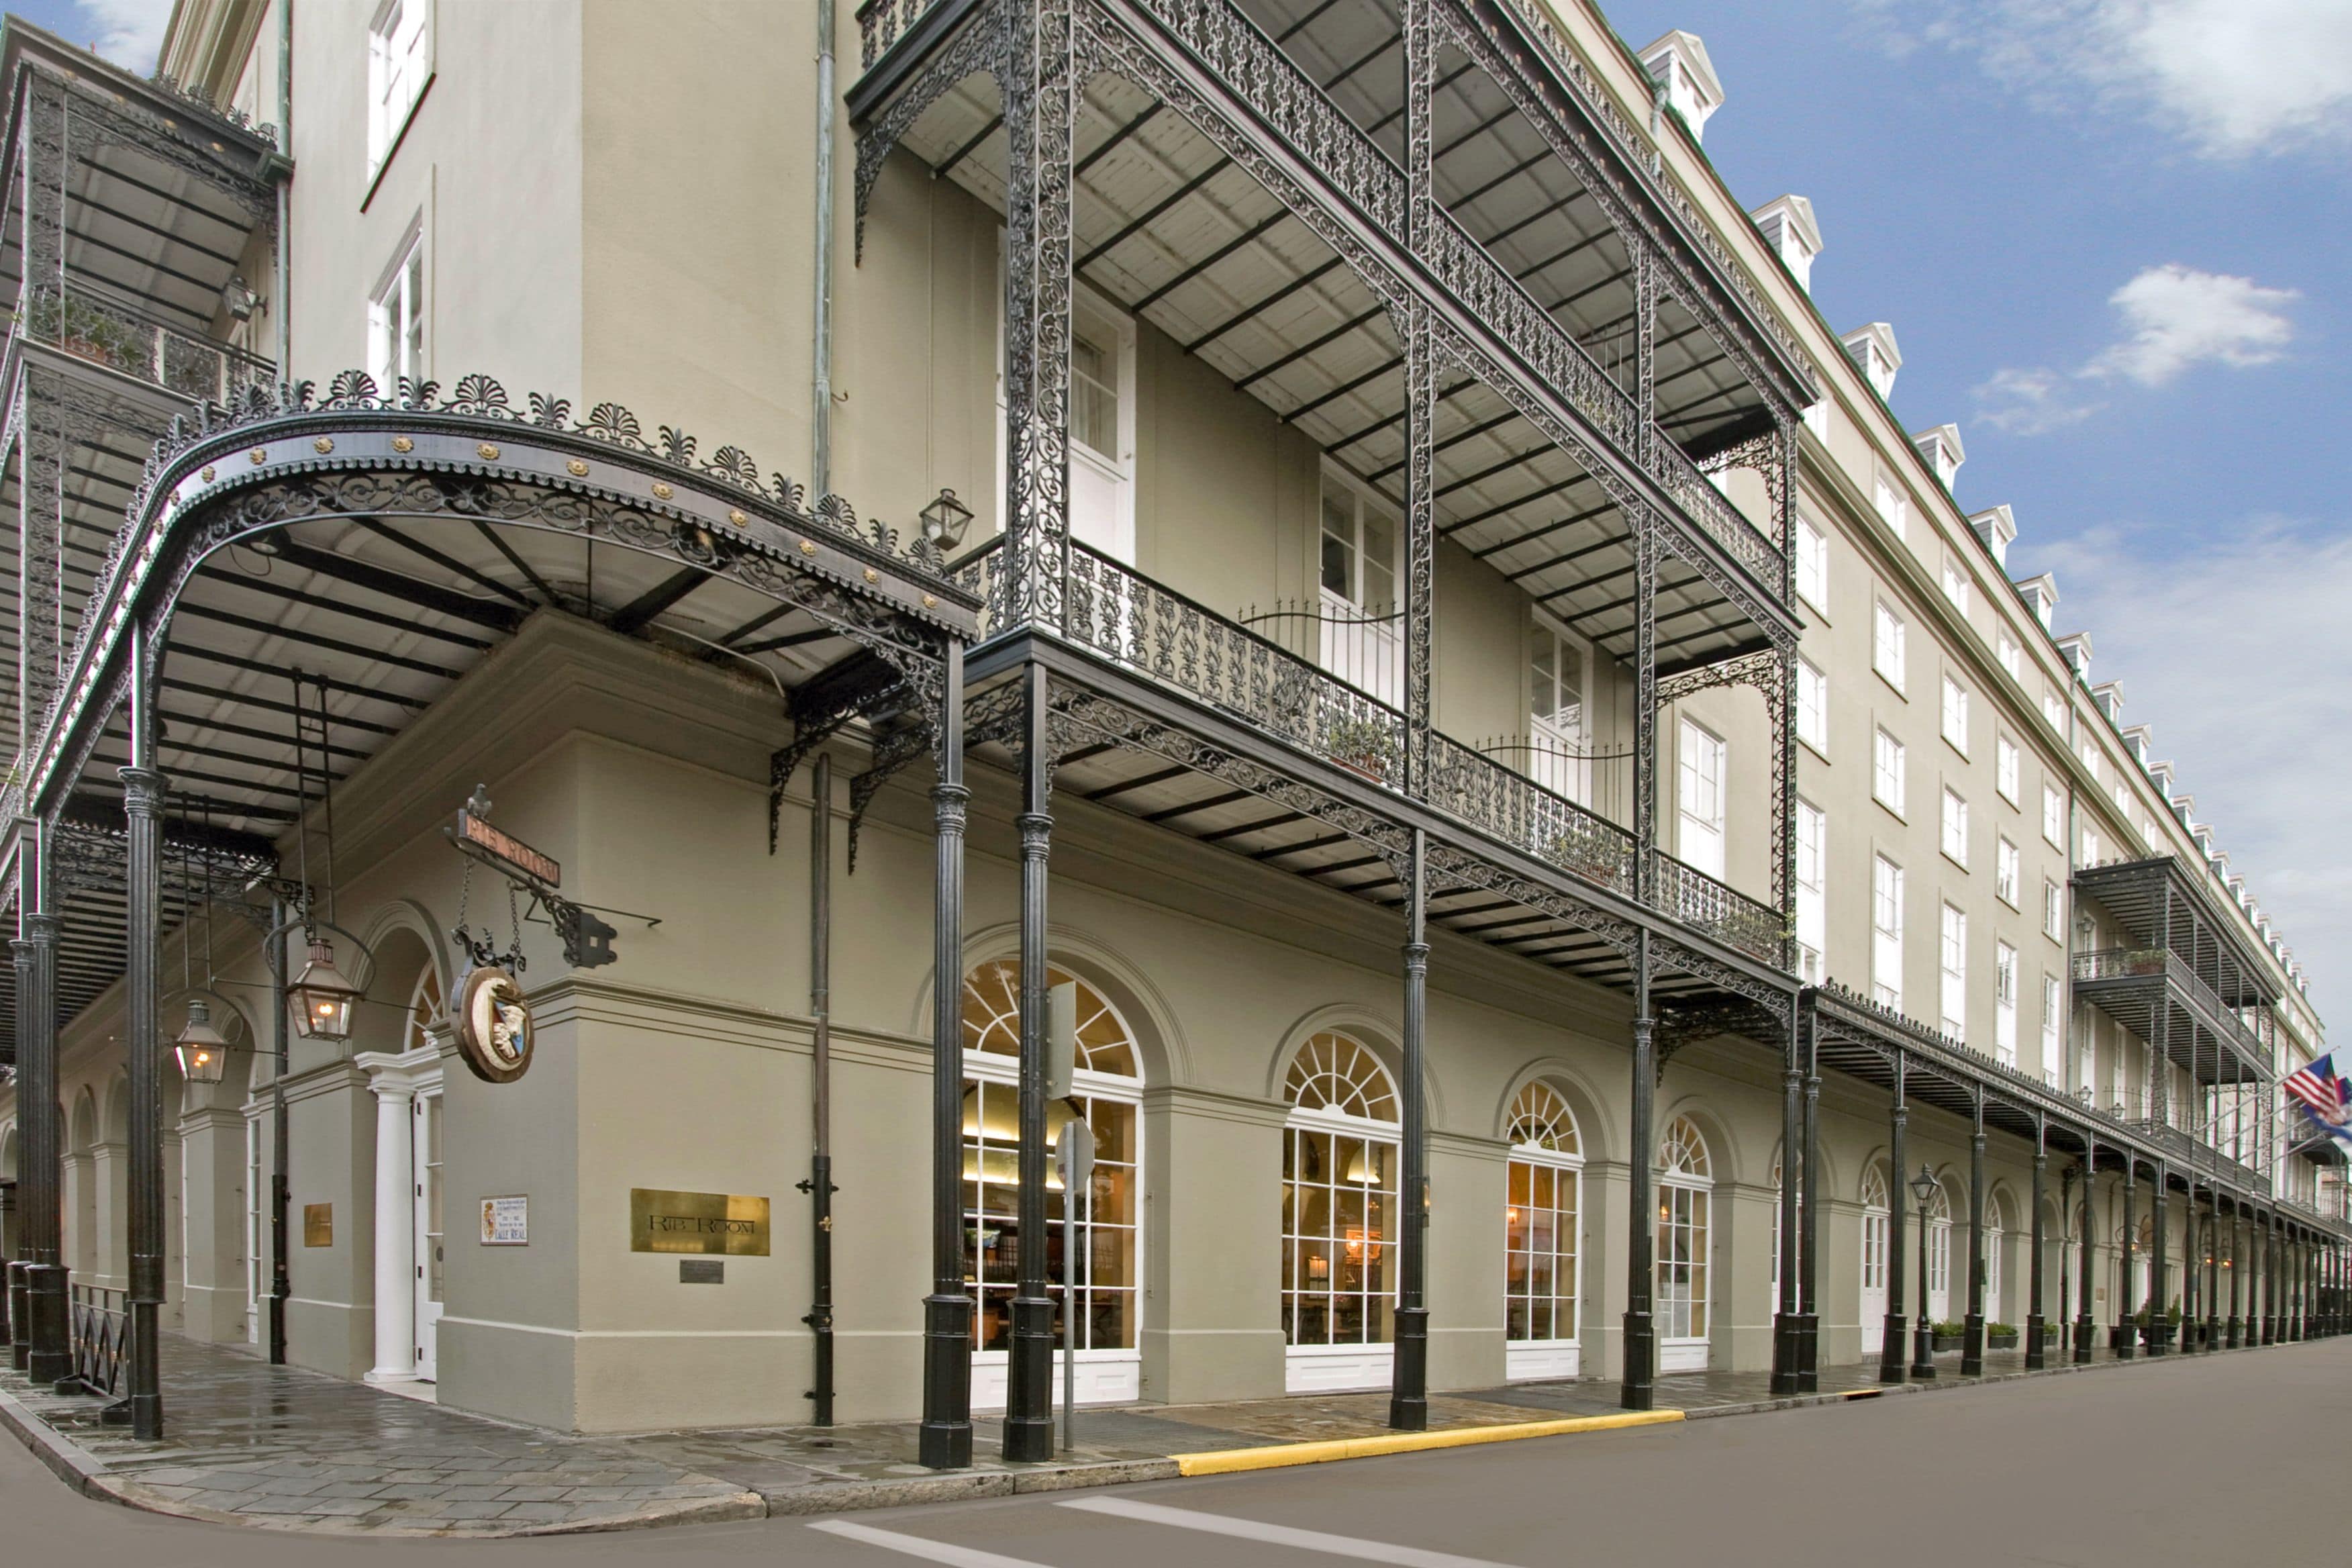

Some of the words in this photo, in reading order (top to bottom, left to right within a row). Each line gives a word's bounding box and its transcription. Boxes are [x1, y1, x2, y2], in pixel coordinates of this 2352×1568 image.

[468, 818, 497, 850] RIB
[508, 839, 556, 882] ROOM
[649, 1216, 686, 1231] RIB
[697, 1218, 754, 1234] ROOM
